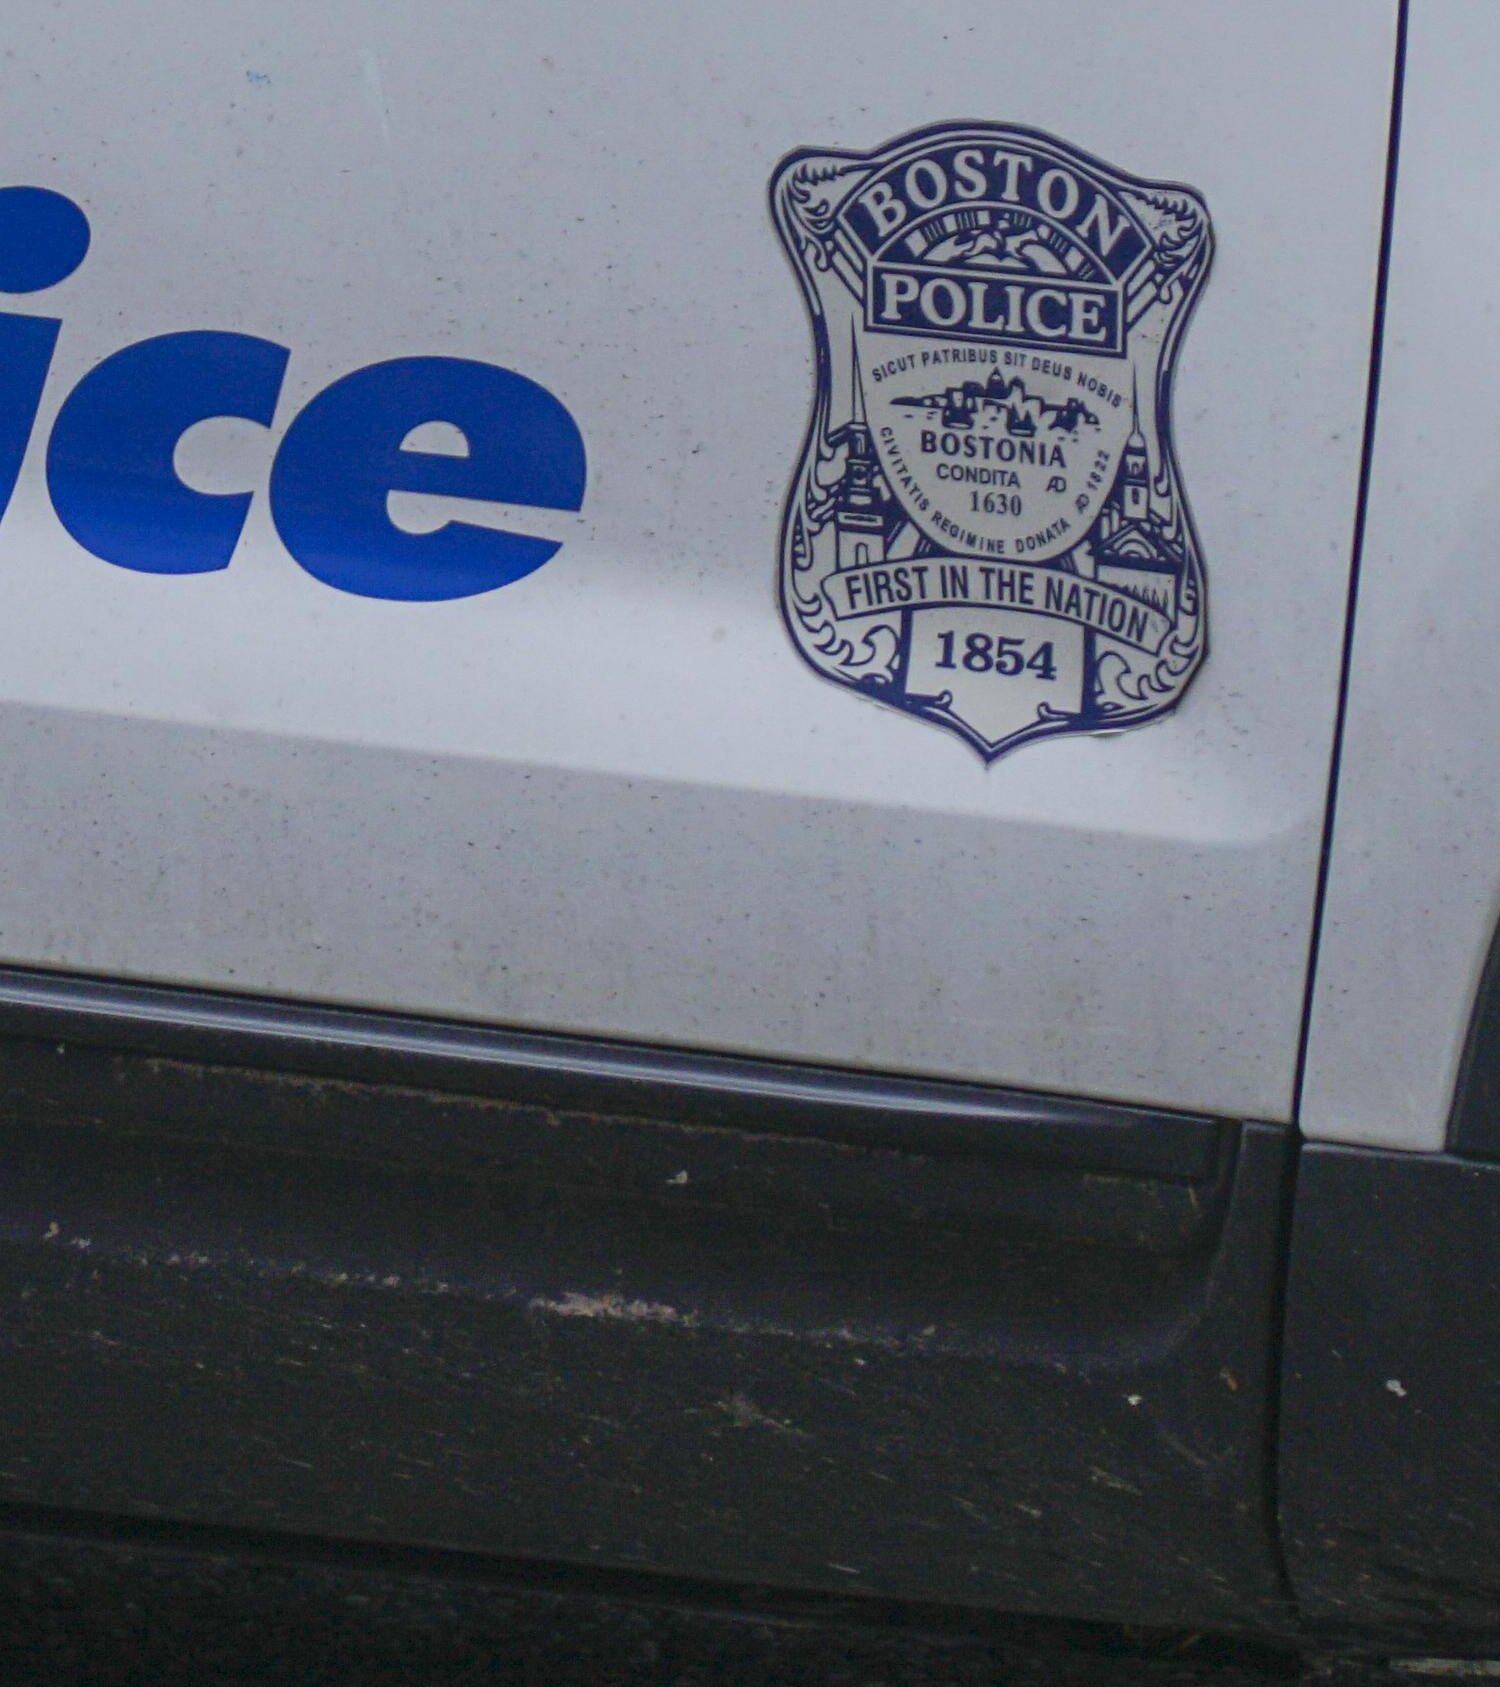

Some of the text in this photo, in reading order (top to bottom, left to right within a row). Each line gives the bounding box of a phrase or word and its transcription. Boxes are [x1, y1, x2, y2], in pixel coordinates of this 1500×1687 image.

[858, 149, 1131, 257] BOSTON
[880, 272, 1107, 342] POLICE
[871, 348, 1122, 408] SICUT PATRIBUS SIT DEUS NOBIS
[920, 429, 1067, 468] BOSTONIA
[936, 463, 1021, 489] CONDITA
[880, 426, 931, 511] CIVITATIS
[930, 510, 1006, 554] REGIMINE
[1015, 517, 1072, 553] DONATA
[1087, 449, 1111, 492] 1822
[969, 490, 1023, 516] 1630
[845, 565, 1149, 643] FIRST IN THE NATION
[934, 630, 1057, 681] 1854
